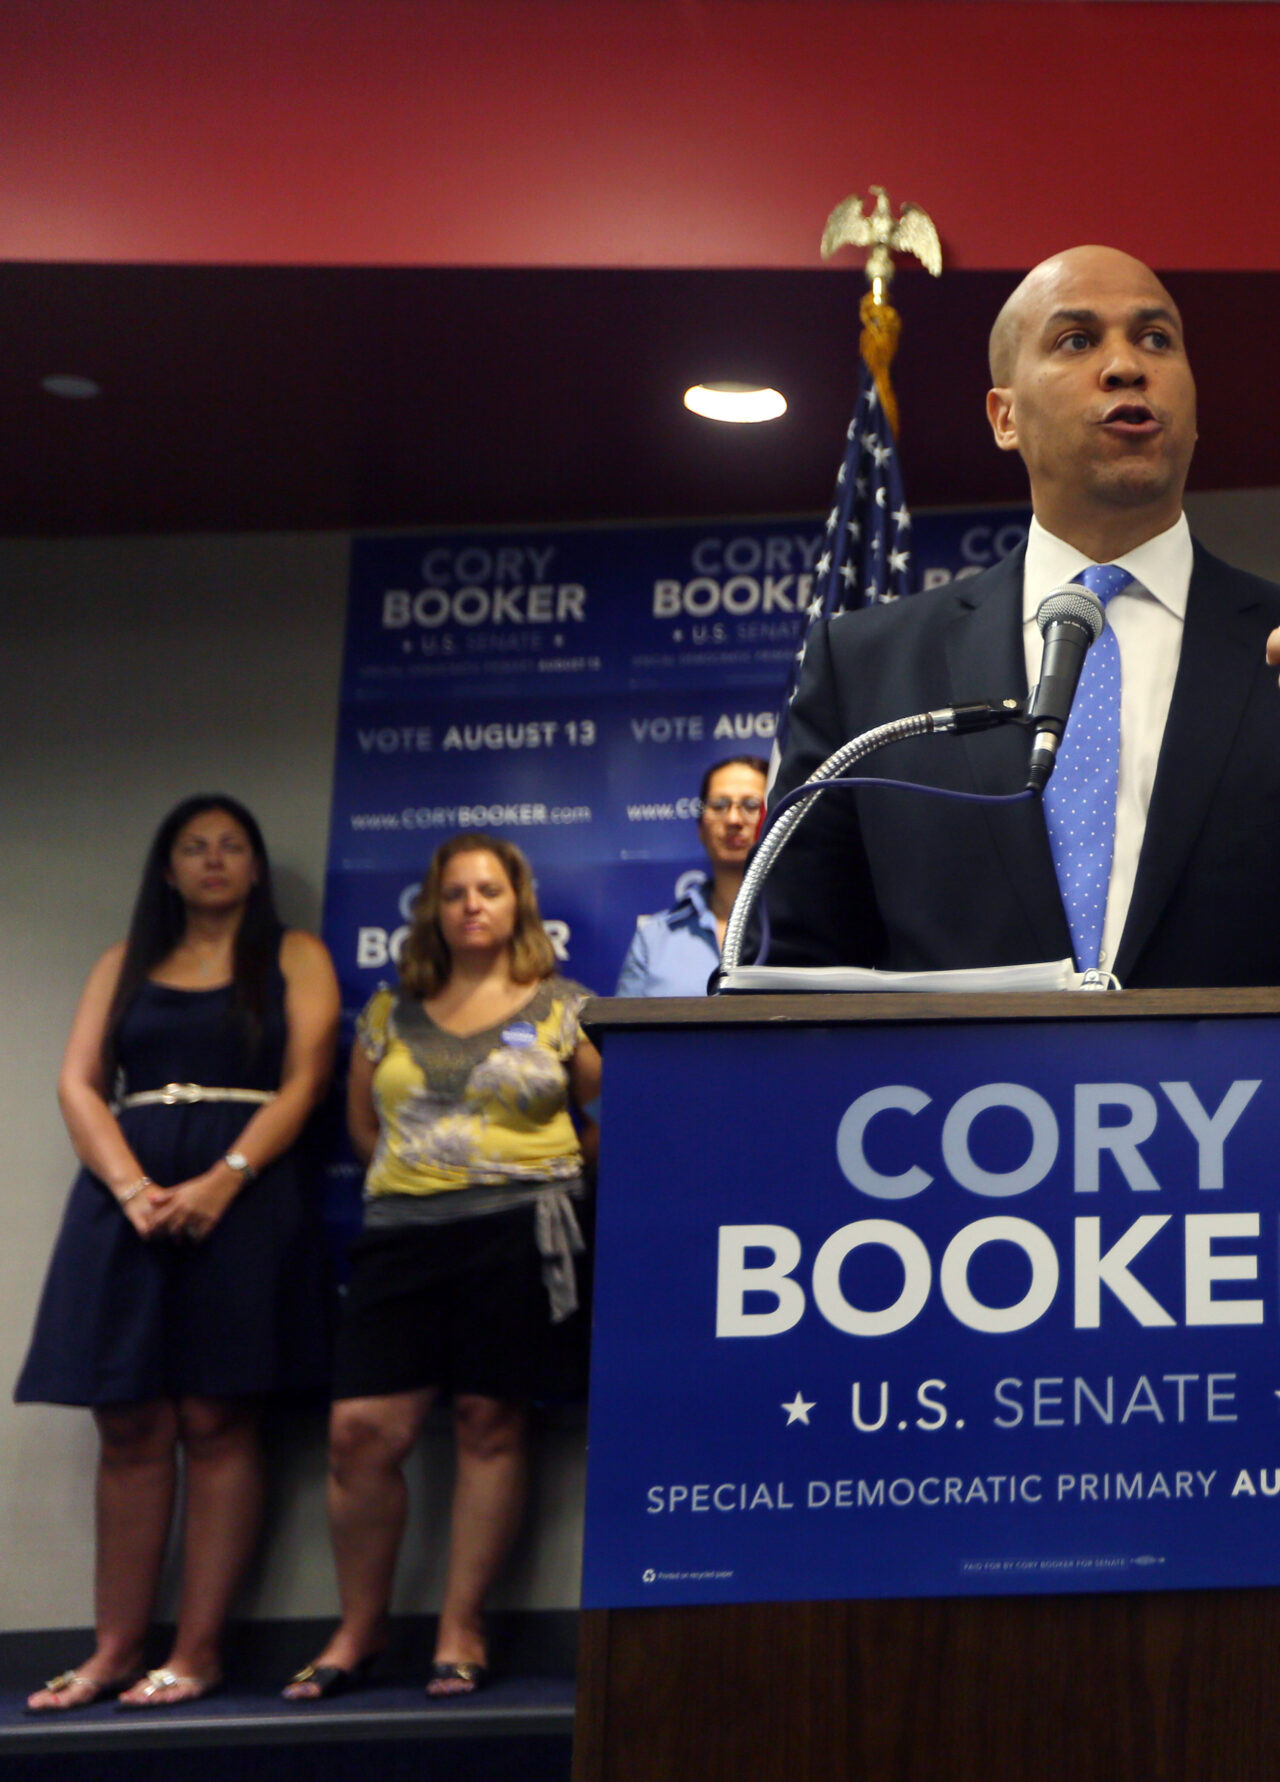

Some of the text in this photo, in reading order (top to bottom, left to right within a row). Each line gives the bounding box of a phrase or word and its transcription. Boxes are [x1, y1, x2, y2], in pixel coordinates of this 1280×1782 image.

[691, 534, 823, 576] CORY
[961, 524, 1028, 563] CO
[421, 545, 556, 586] CORY
[381, 582, 588, 629] BOOKER
[652, 573, 813, 619] BOOK
[736, 618, 801, 642] SENAT
[356, 719, 597, 753] VOTE AUGUST 13
[630, 711, 776, 743] VOTE AUG
[351, 803, 592, 831] www.CORYBOOKER.com
[836, 1079, 1263, 1201] CORY
[850, 1372, 1239, 1433] U.S. SENATE
[646, 1480, 795, 1515] SPECIAL
[807, 1474, 1043, 1510] DEMOCRATIC
[1057, 1470, 1219, 1503] PRIMARY
[963, 1563, 982, 1571] PAID
[984, 1562, 1001, 1570] FOR
[1003, 1562, 1014, 1570] BY
[1015, 1561, 1038, 1569] CORY
[1040, 1560, 1074, 1569] BOOKER
[1076, 1559, 1093, 1568] FOR
[1094, 1558, 1126, 1567] SENATE
